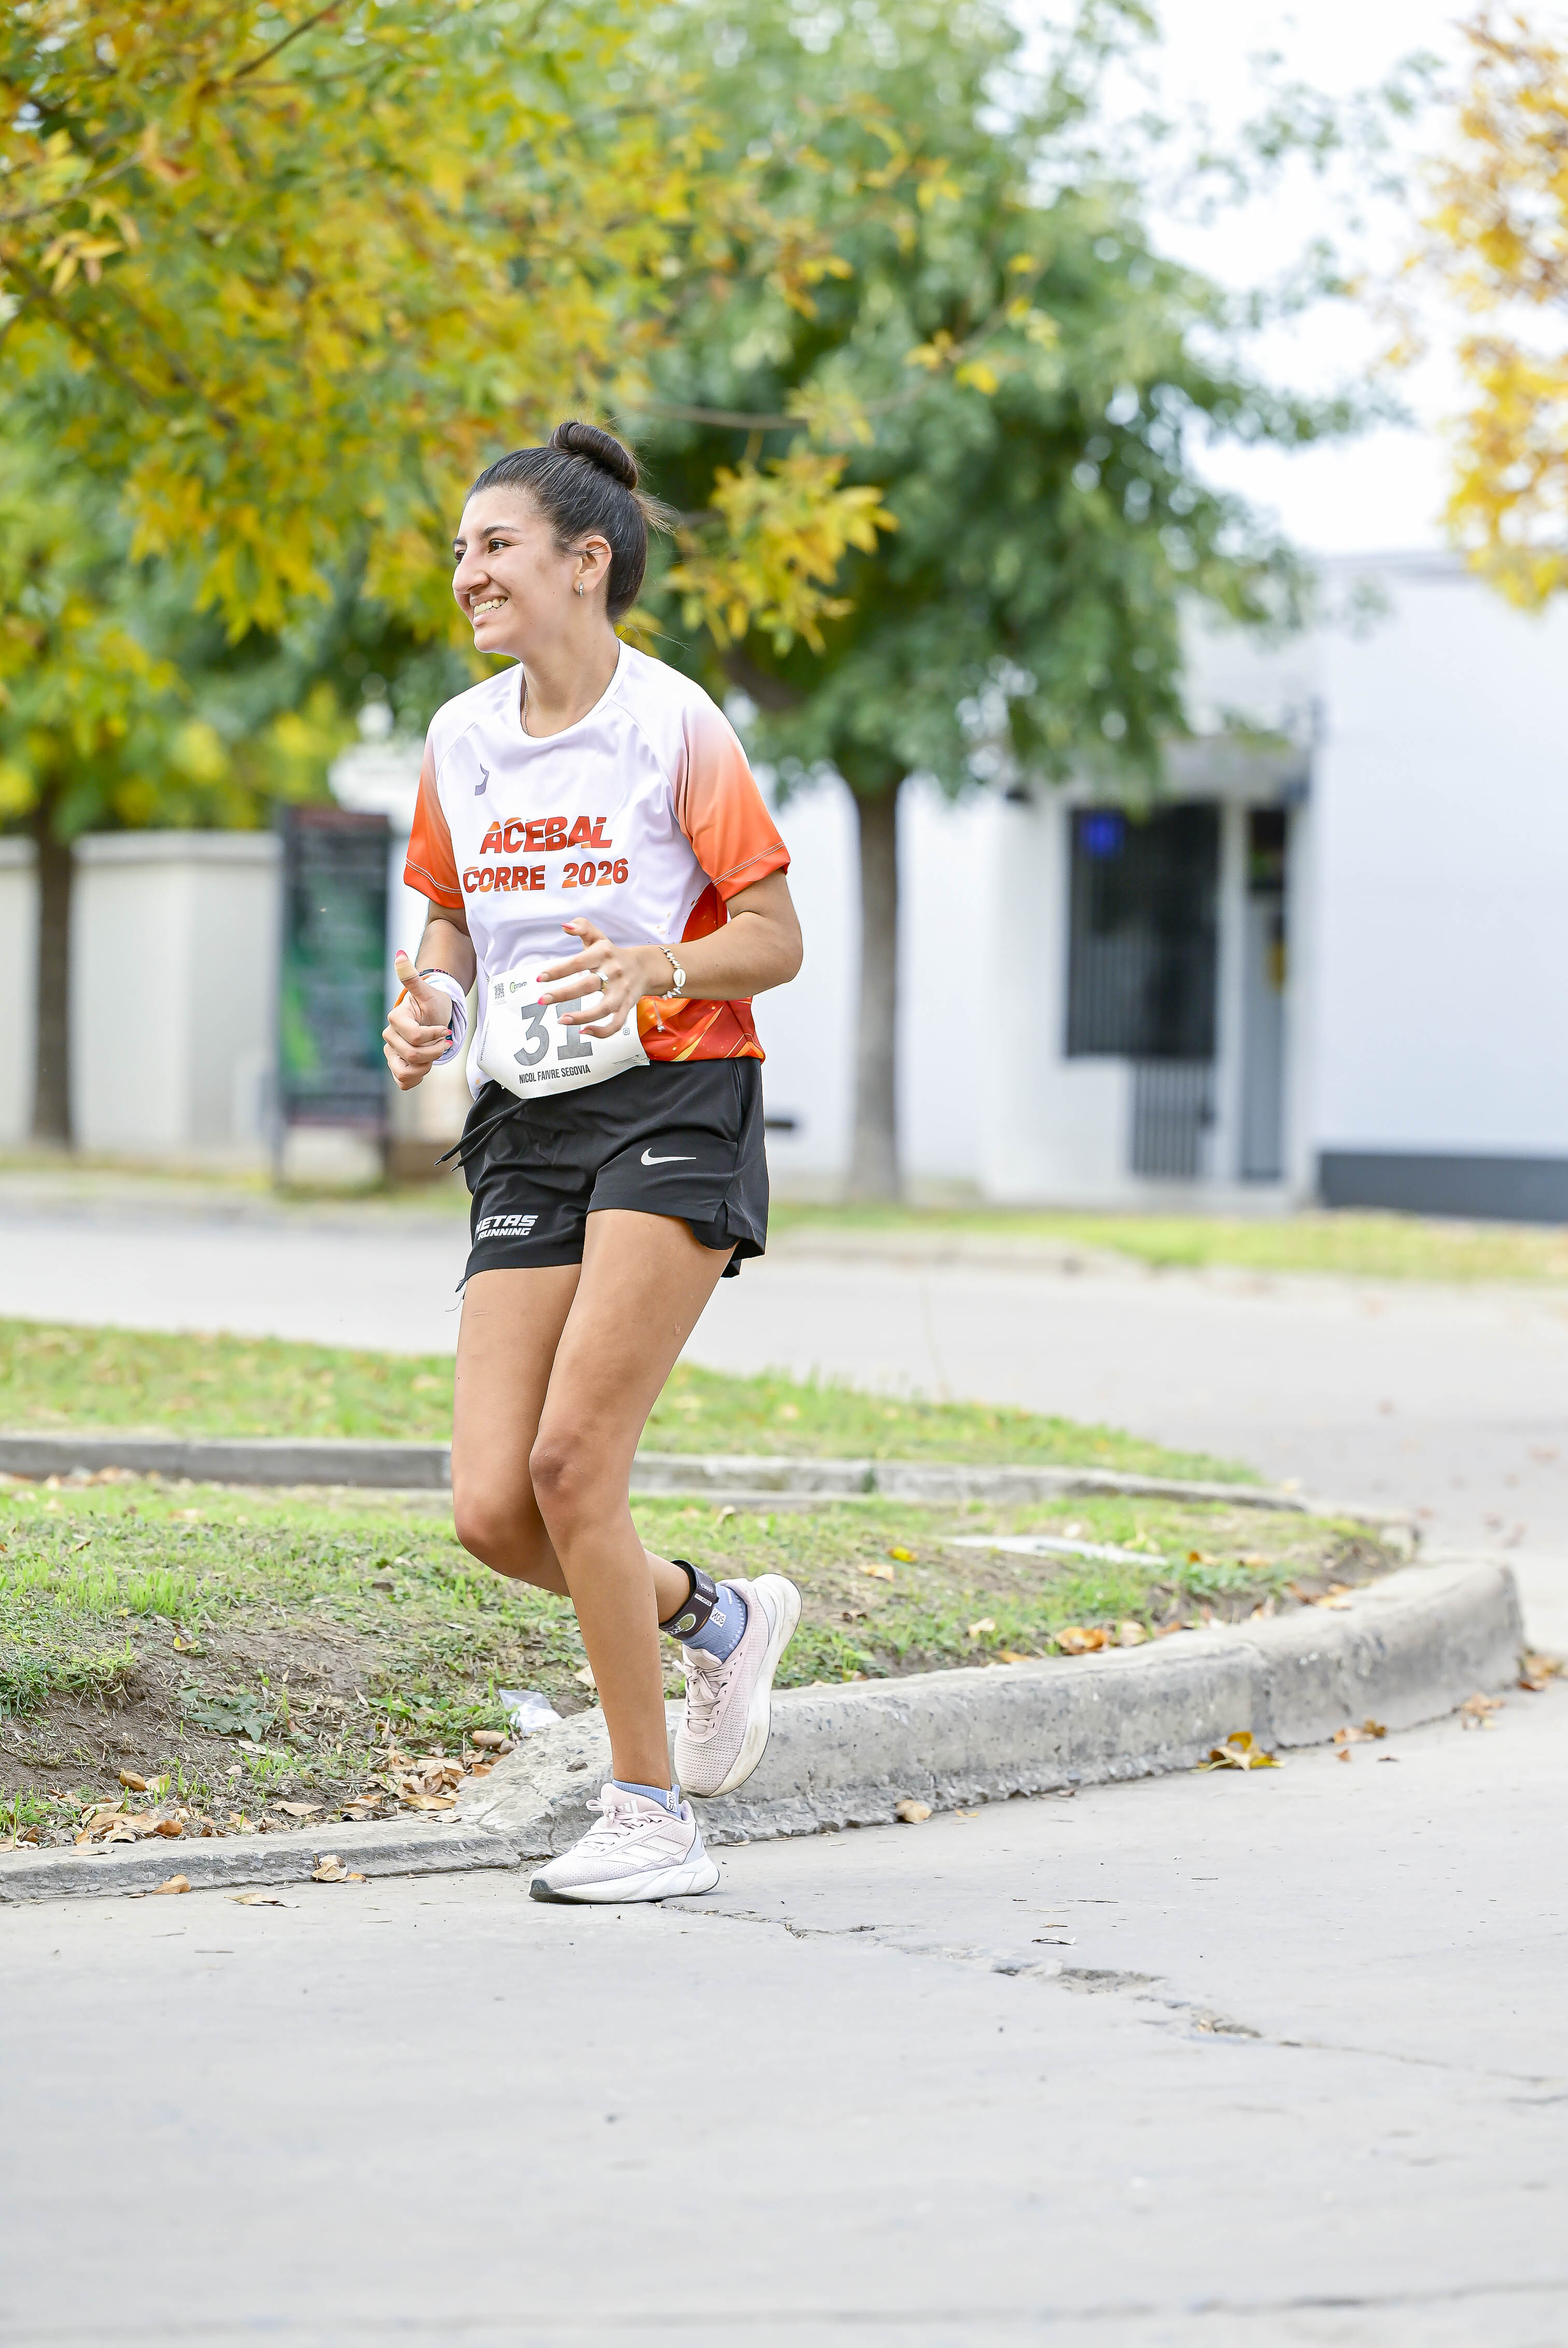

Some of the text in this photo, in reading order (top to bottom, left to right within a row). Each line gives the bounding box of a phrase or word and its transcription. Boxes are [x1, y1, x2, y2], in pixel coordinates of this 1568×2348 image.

[480, 816, 612, 854] ACEBAL
[463, 858, 628, 893] CORRE 2026
[514, 997, 593, 1066] 31
[519, 1064, 591, 1084] NICOL FAIVRE SEGOVIA
[477, 1227, 531, 1241] RUNNING
